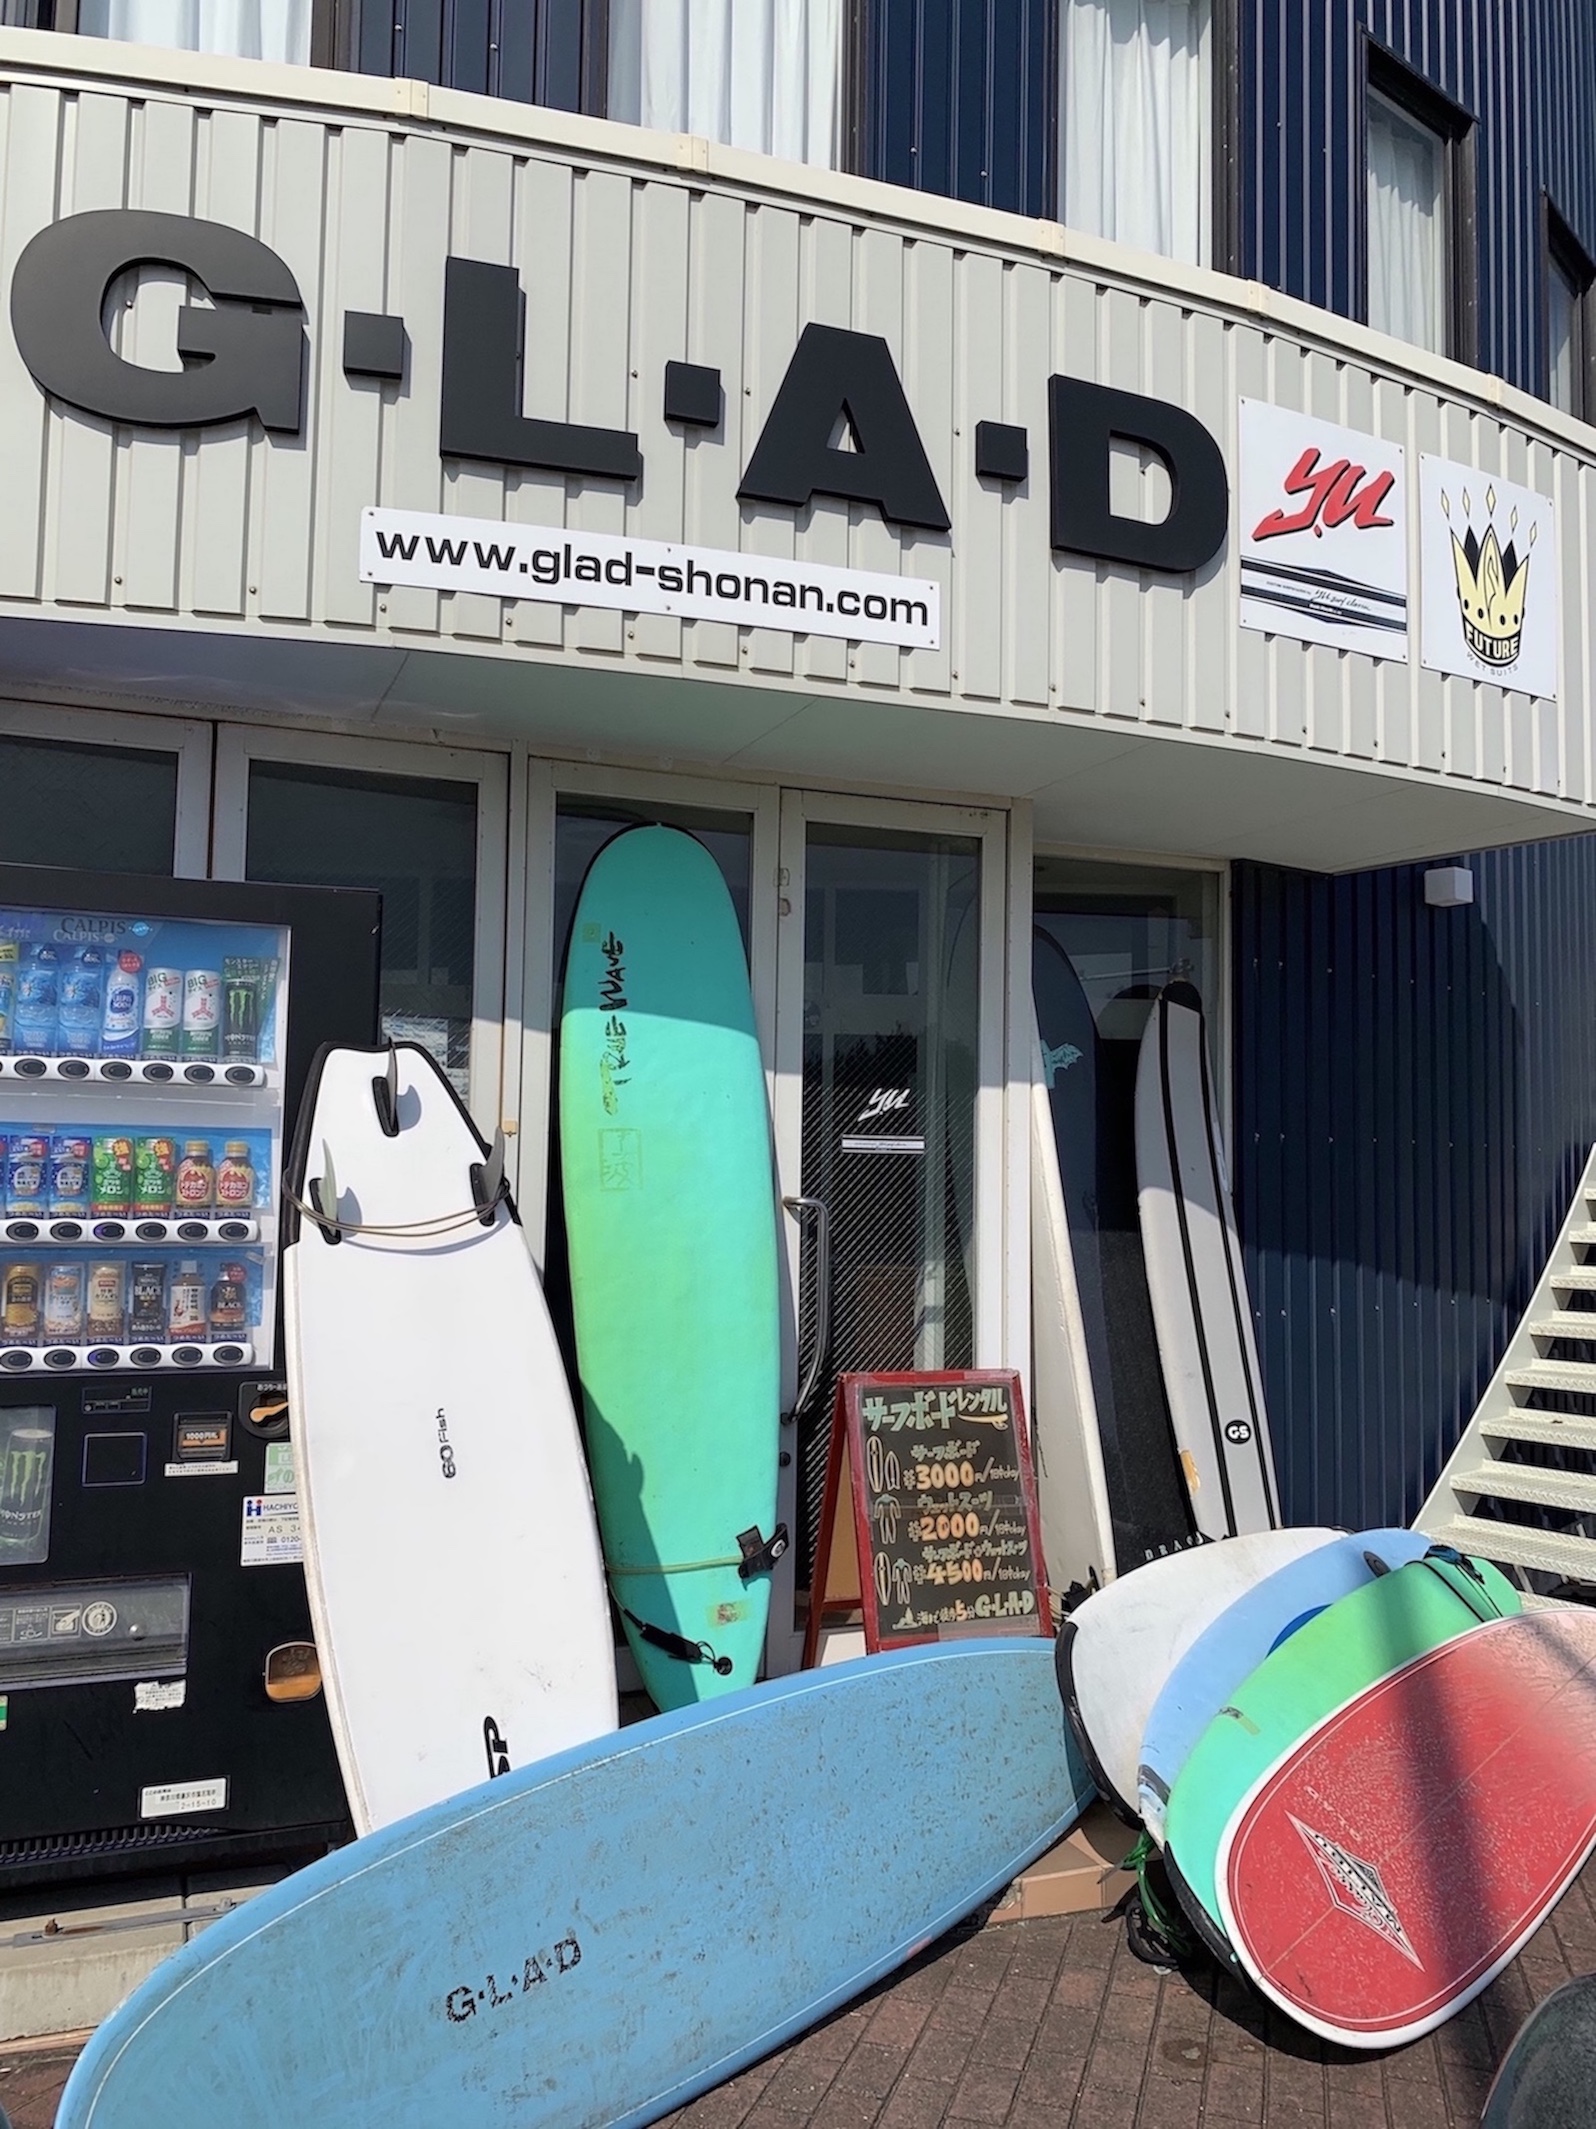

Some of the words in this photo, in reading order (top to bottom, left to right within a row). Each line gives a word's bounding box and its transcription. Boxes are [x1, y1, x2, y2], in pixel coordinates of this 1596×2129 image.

[376, 531, 929, 626] www.glad-shonan.com
[1465, 620, 1519, 659] FUTURE
[1466, 651, 1487, 671] WET
[1490, 664, 1519, 676] SUITS
[60, 917, 126, 935] CALPIS
[187, 974, 207, 988] BIG
[598, 931, 628, 1012] WAVE
[435, 1407, 449, 1444] Fish
[268, 1524, 283, 1534] AS
[1314, 1833, 1402, 1934] MALIBU
